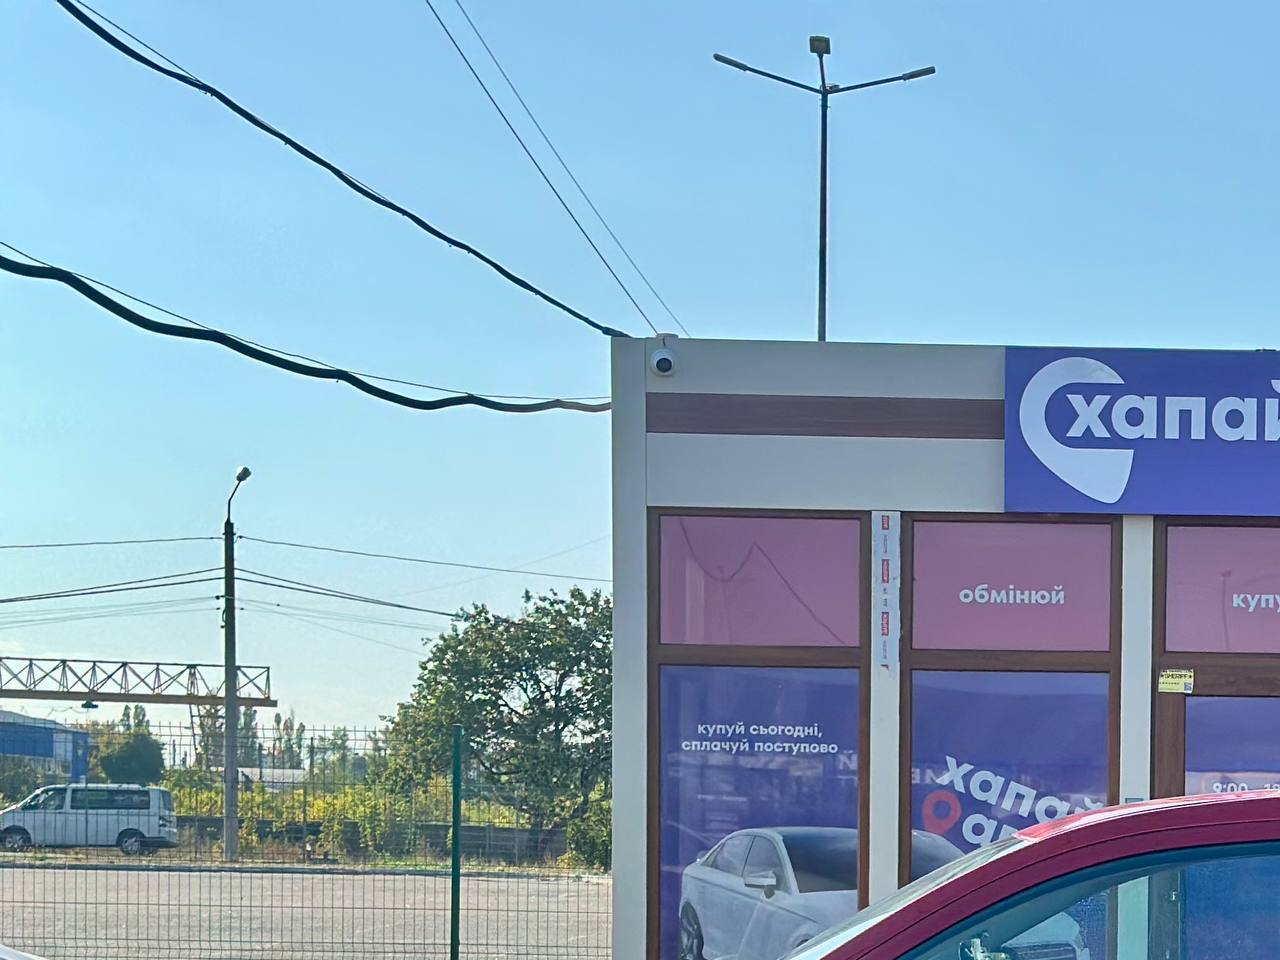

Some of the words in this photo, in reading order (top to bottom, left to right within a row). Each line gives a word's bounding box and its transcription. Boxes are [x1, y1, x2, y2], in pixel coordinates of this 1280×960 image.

[959, 583, 1065, 604] обмінюй
[697, 722, 745, 737] купуй
[750, 723, 823, 738] сьогодні,
[681, 739, 749, 754] сплачуй
[754, 742, 839, 755] поступово
